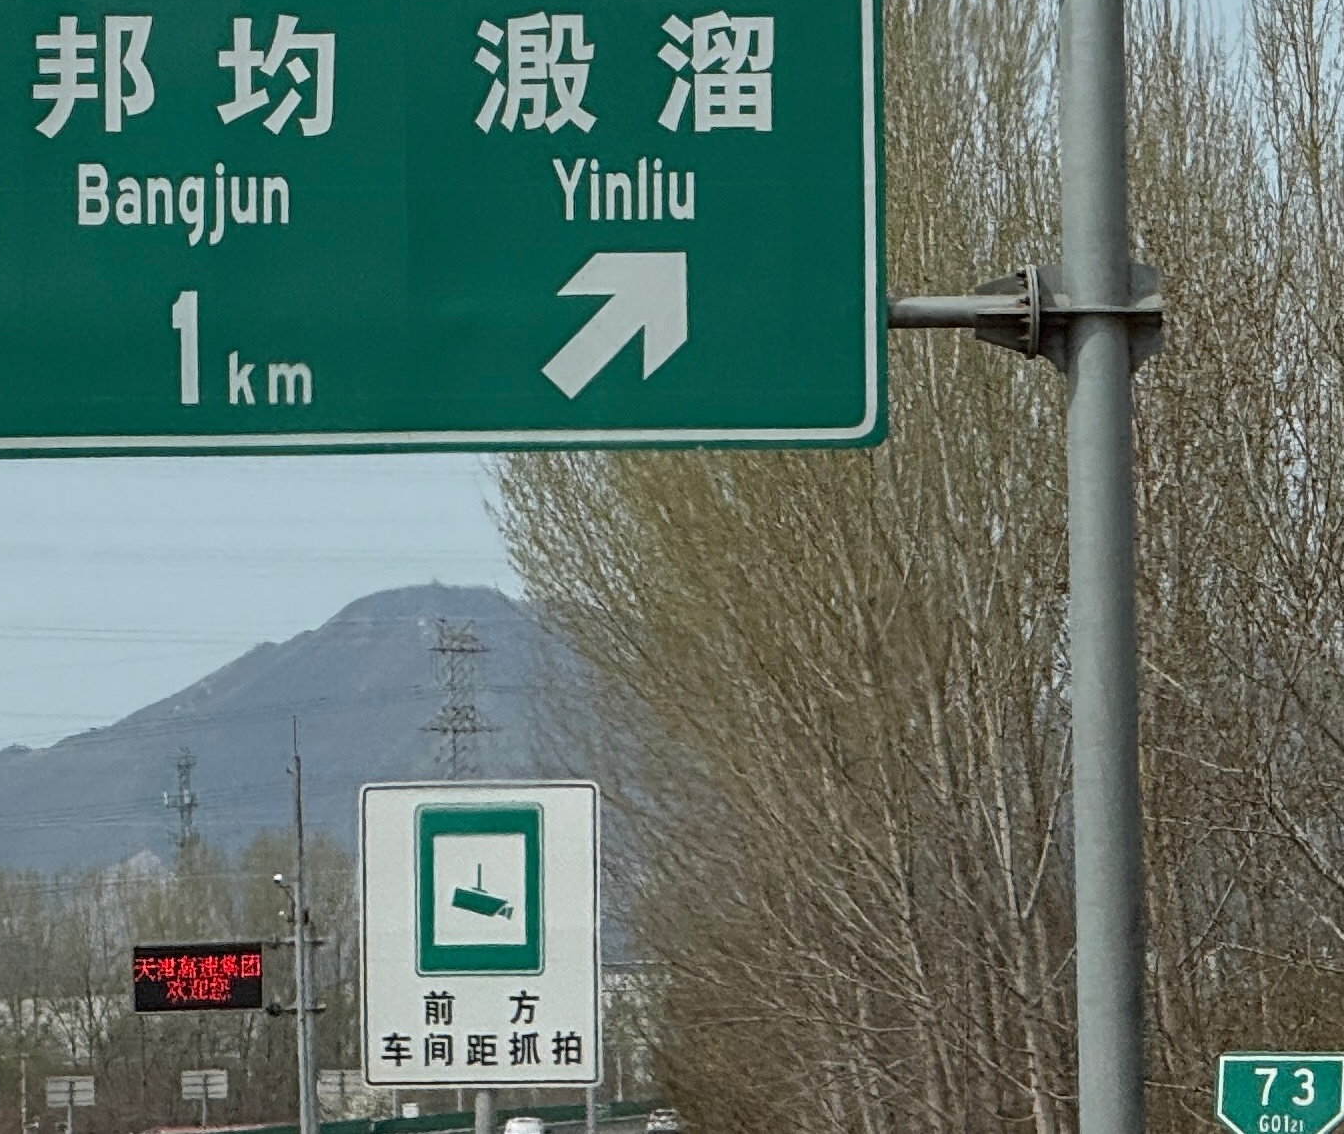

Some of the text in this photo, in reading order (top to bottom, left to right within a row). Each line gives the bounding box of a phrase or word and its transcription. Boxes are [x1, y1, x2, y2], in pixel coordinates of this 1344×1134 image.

[32, 14, 336, 139] 邦均
[78, 156, 695, 247] Bangjun Yinliu
[171, 290, 312, 405] 1 km
[381, 1030, 582, 1067] 车间距抓拍
[1254, 1067, 1316, 1107] 73
[1258, 1114, 1304, 1133] G0121
